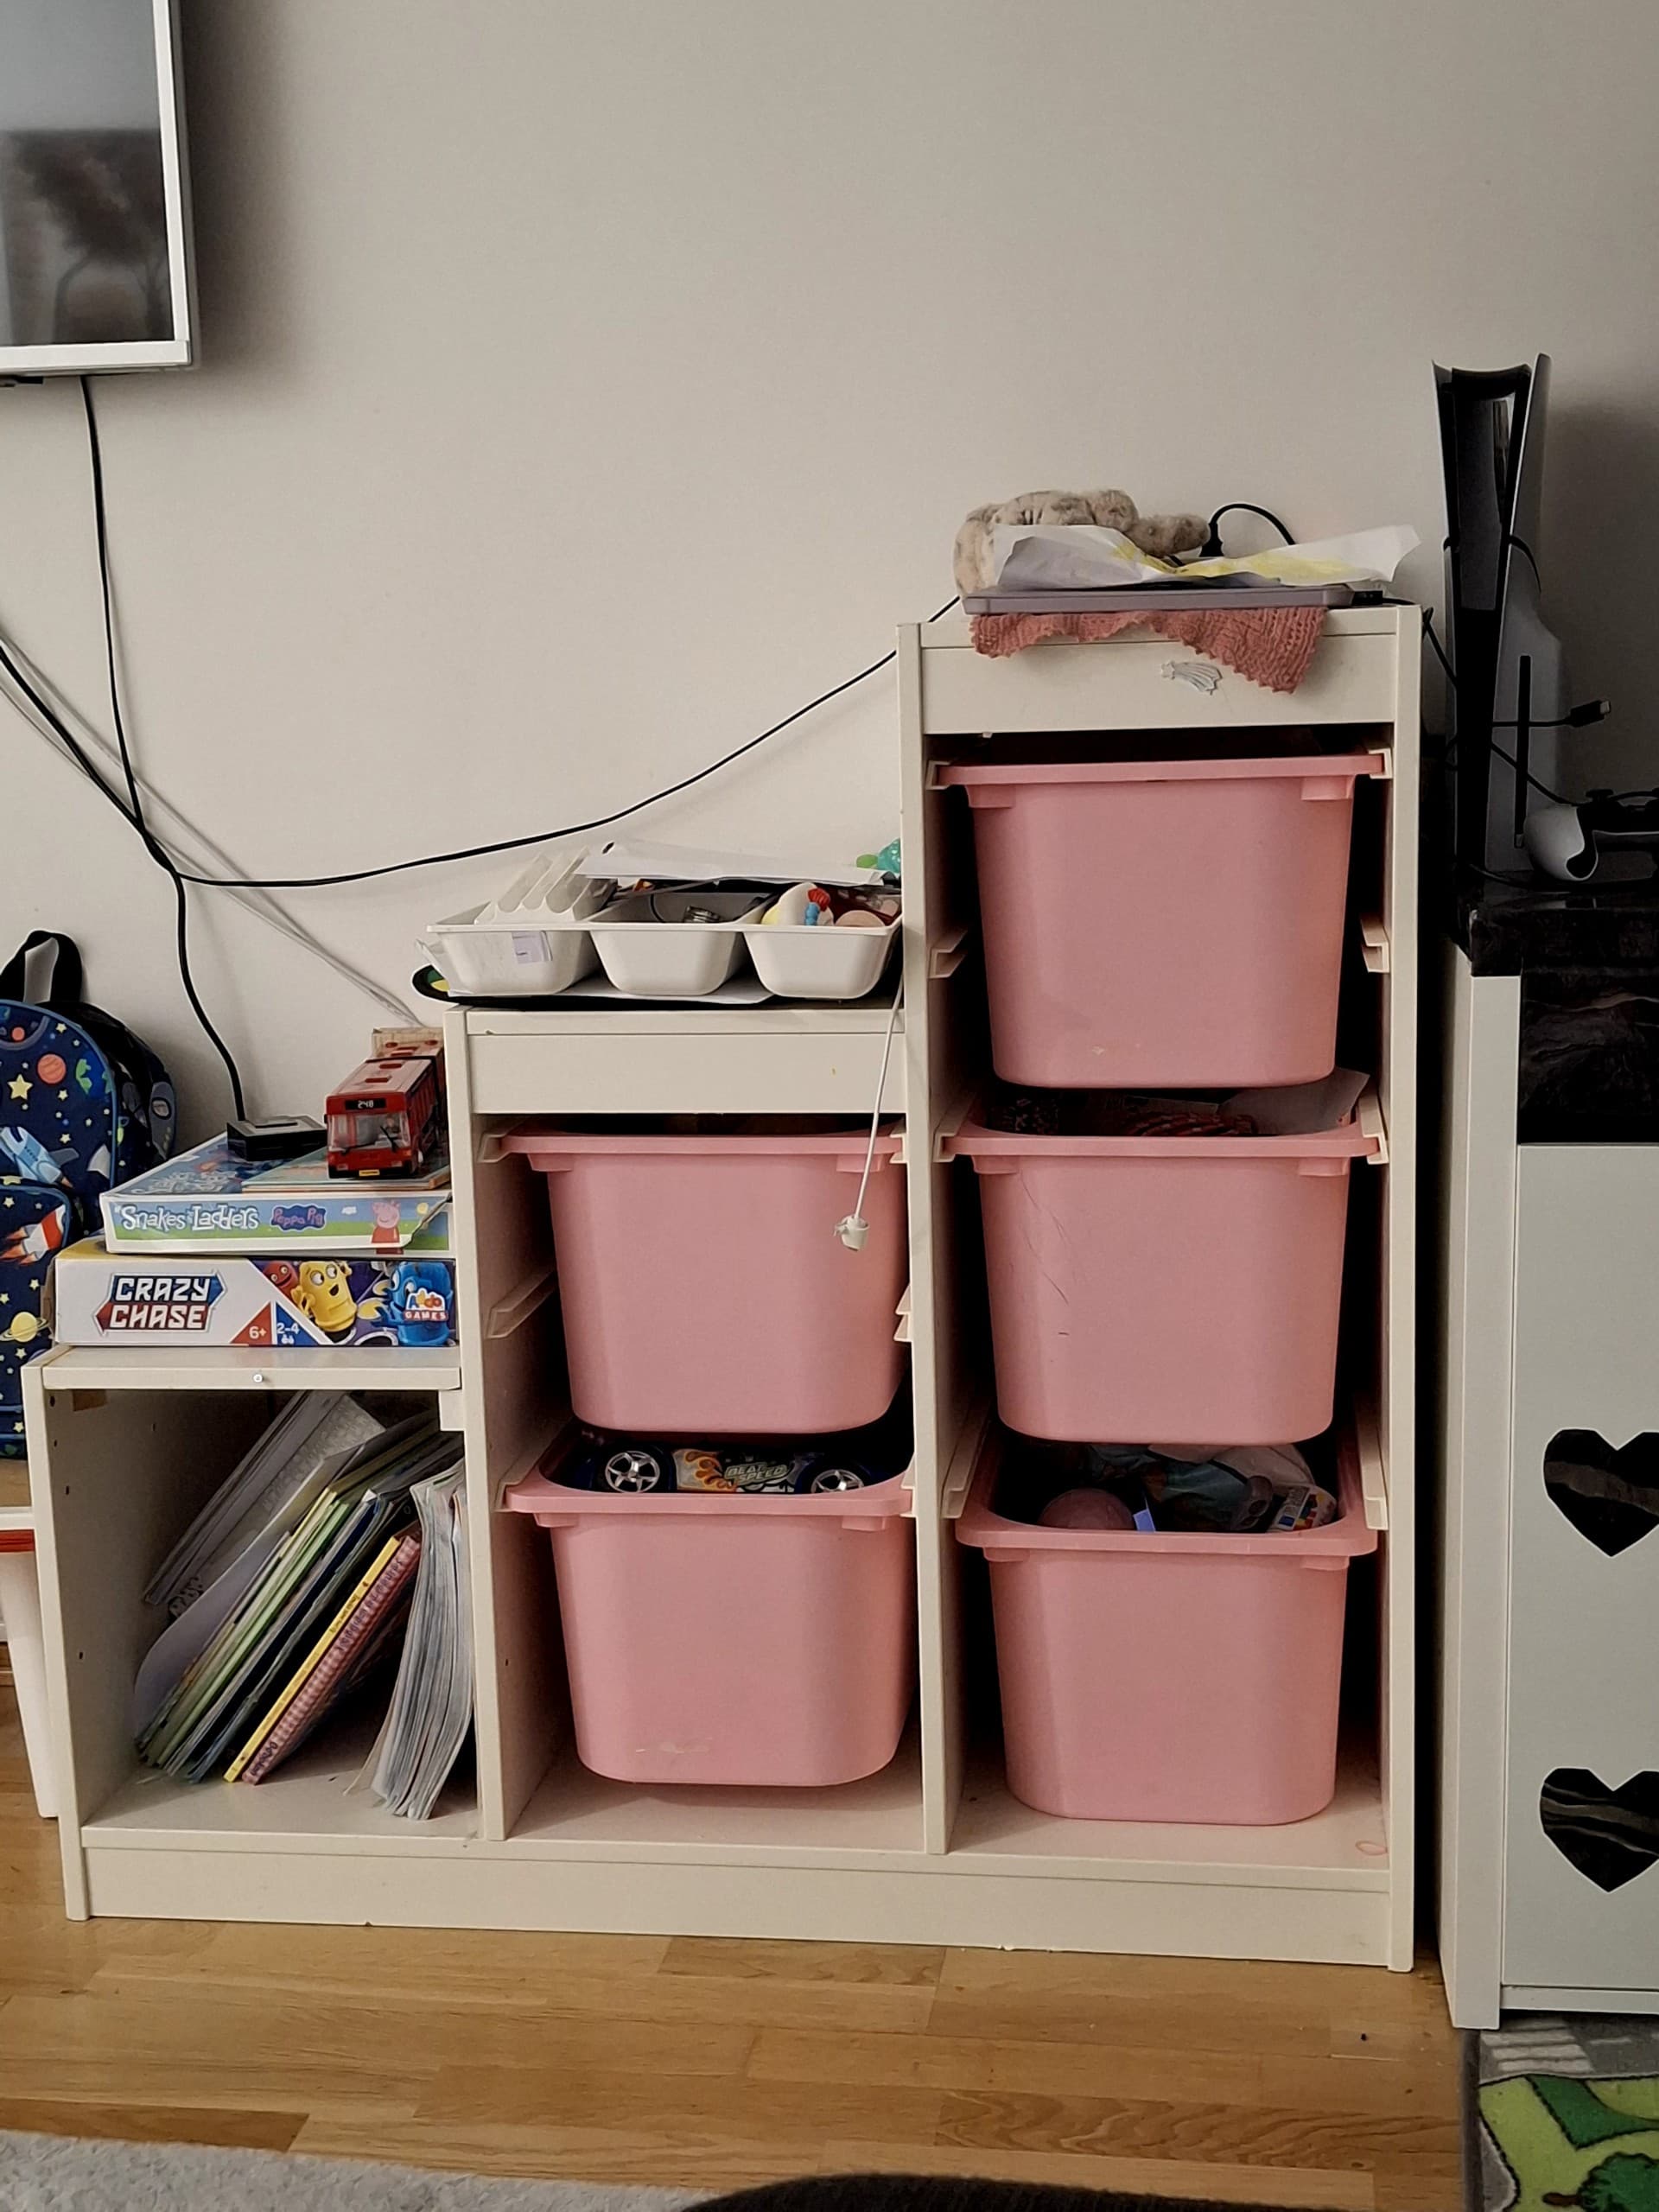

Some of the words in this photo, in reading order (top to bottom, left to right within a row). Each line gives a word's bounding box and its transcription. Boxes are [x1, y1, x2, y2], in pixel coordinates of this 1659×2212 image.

[121, 1205, 186, 1231] Snakes
[191, 1205, 259, 1230] Ladders
[273, 1208, 305, 1229] Peppa
[307, 1207, 323, 1226] Pig
[115, 1277, 211, 1301] CRAZY
[109, 1304, 206, 1328] CHASE
[249, 1325, 267, 1339] 6+
[276, 1322, 300, 1335] 2-4
